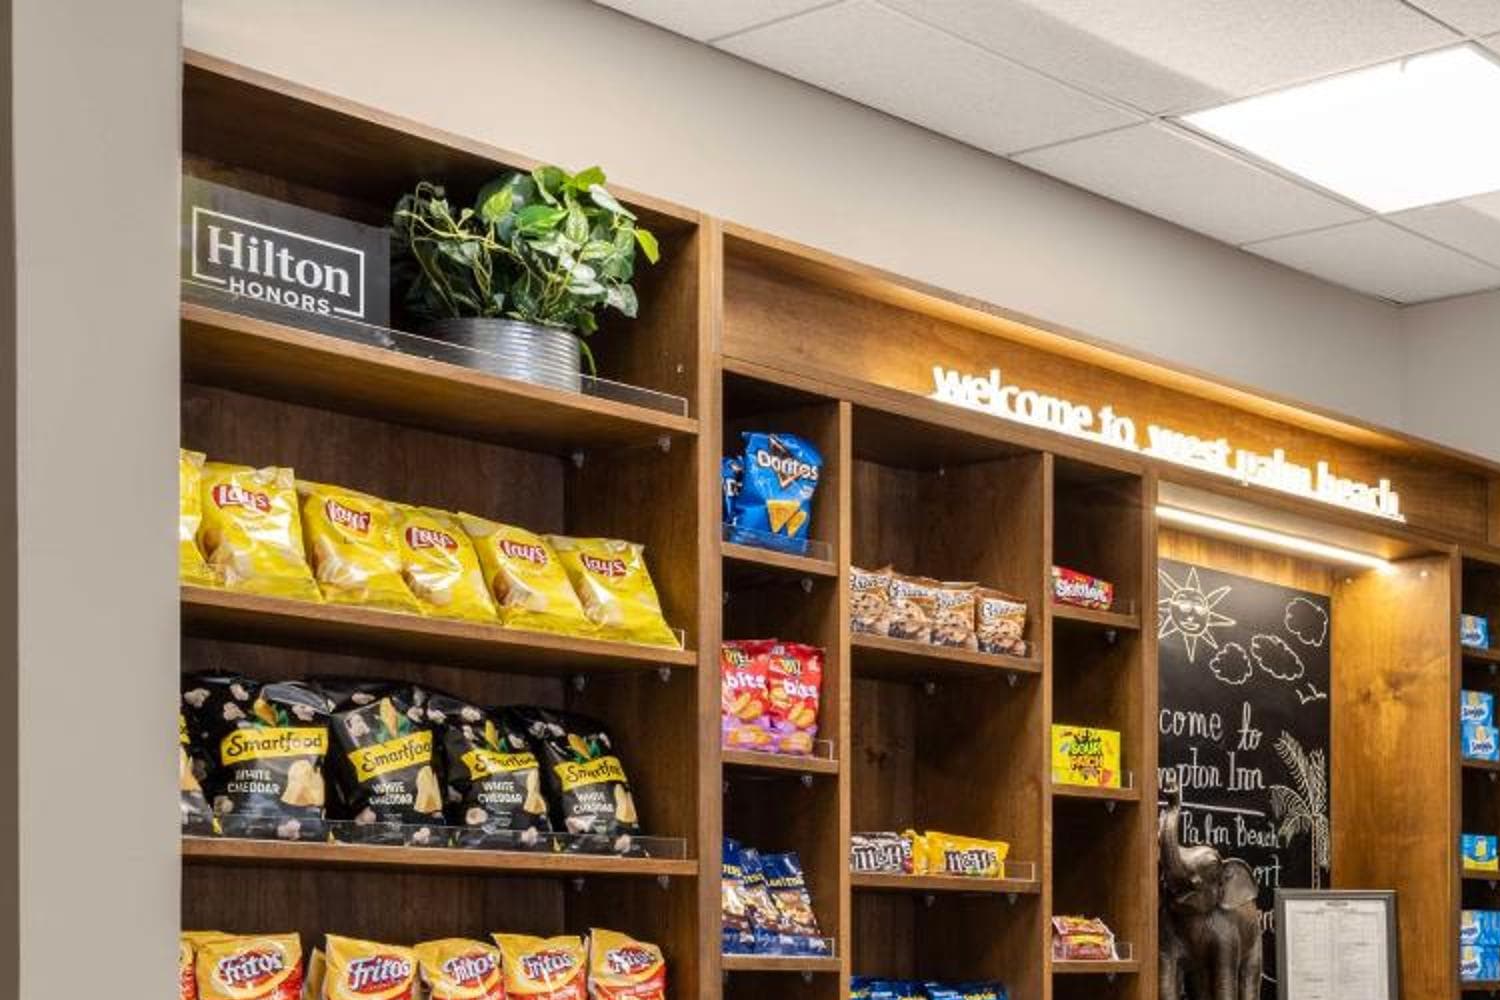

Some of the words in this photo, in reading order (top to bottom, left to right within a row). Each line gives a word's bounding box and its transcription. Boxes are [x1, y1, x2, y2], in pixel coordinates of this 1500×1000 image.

[207, 225, 351, 297] Hilton
[229, 276, 331, 314] HONORS
[932, 366, 1094, 434] welcome
[1099, 405, 1137, 449] to
[227, 732, 322, 757] Smartfood
[1159, 707, 1222, 740] come
[1237, 701, 1263, 750] to
[1227, 751, 1265, 791] Inn
[1180, 810, 1231, 846] Palm
[1236, 814, 1281, 848] Beach
[218, 951, 283, 985] Fritos
[350, 957, 412, 989] Fritos
